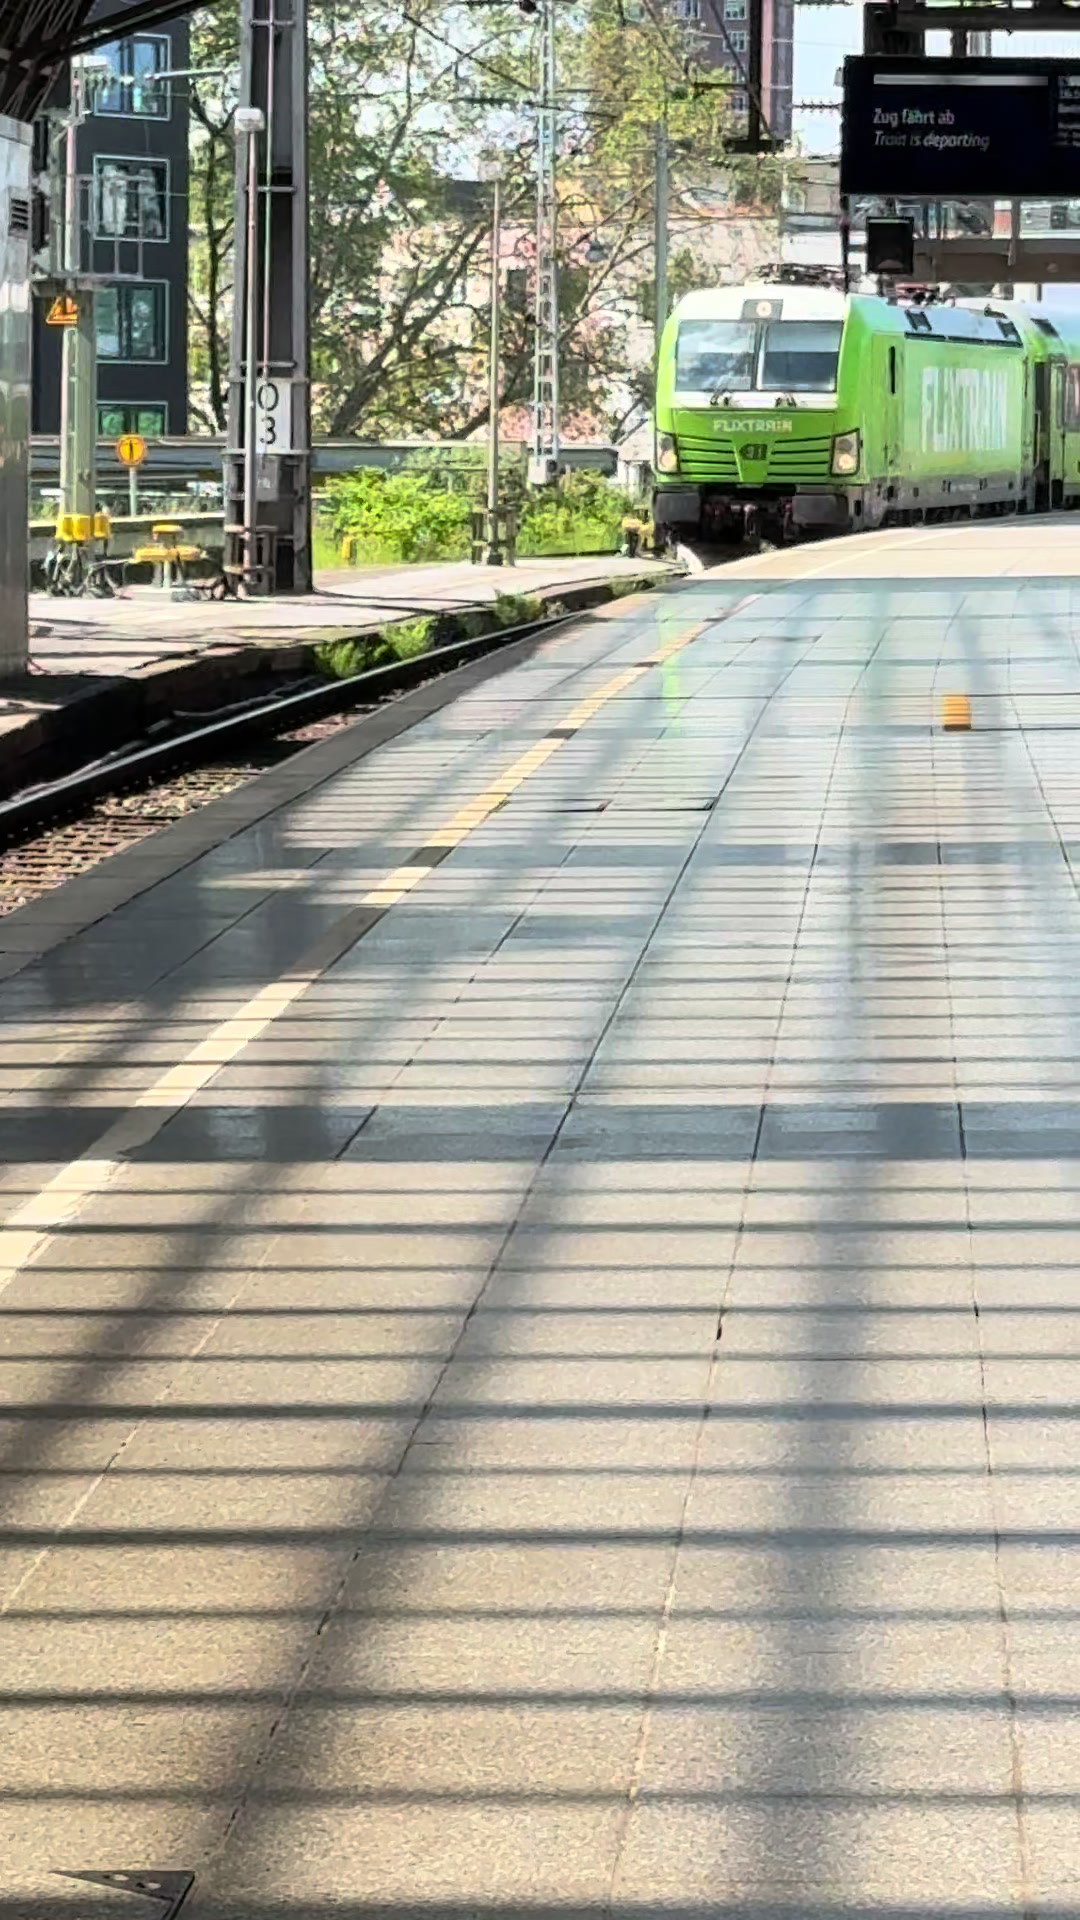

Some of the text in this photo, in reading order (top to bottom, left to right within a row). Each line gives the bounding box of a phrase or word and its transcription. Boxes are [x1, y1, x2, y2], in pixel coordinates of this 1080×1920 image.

[873, 107, 955, 128] Zug fährt ab
[910, 134, 921, 146] is
[923, 131, 990, 152] departing
[713, 419, 793, 432] FLIXTRAIN
